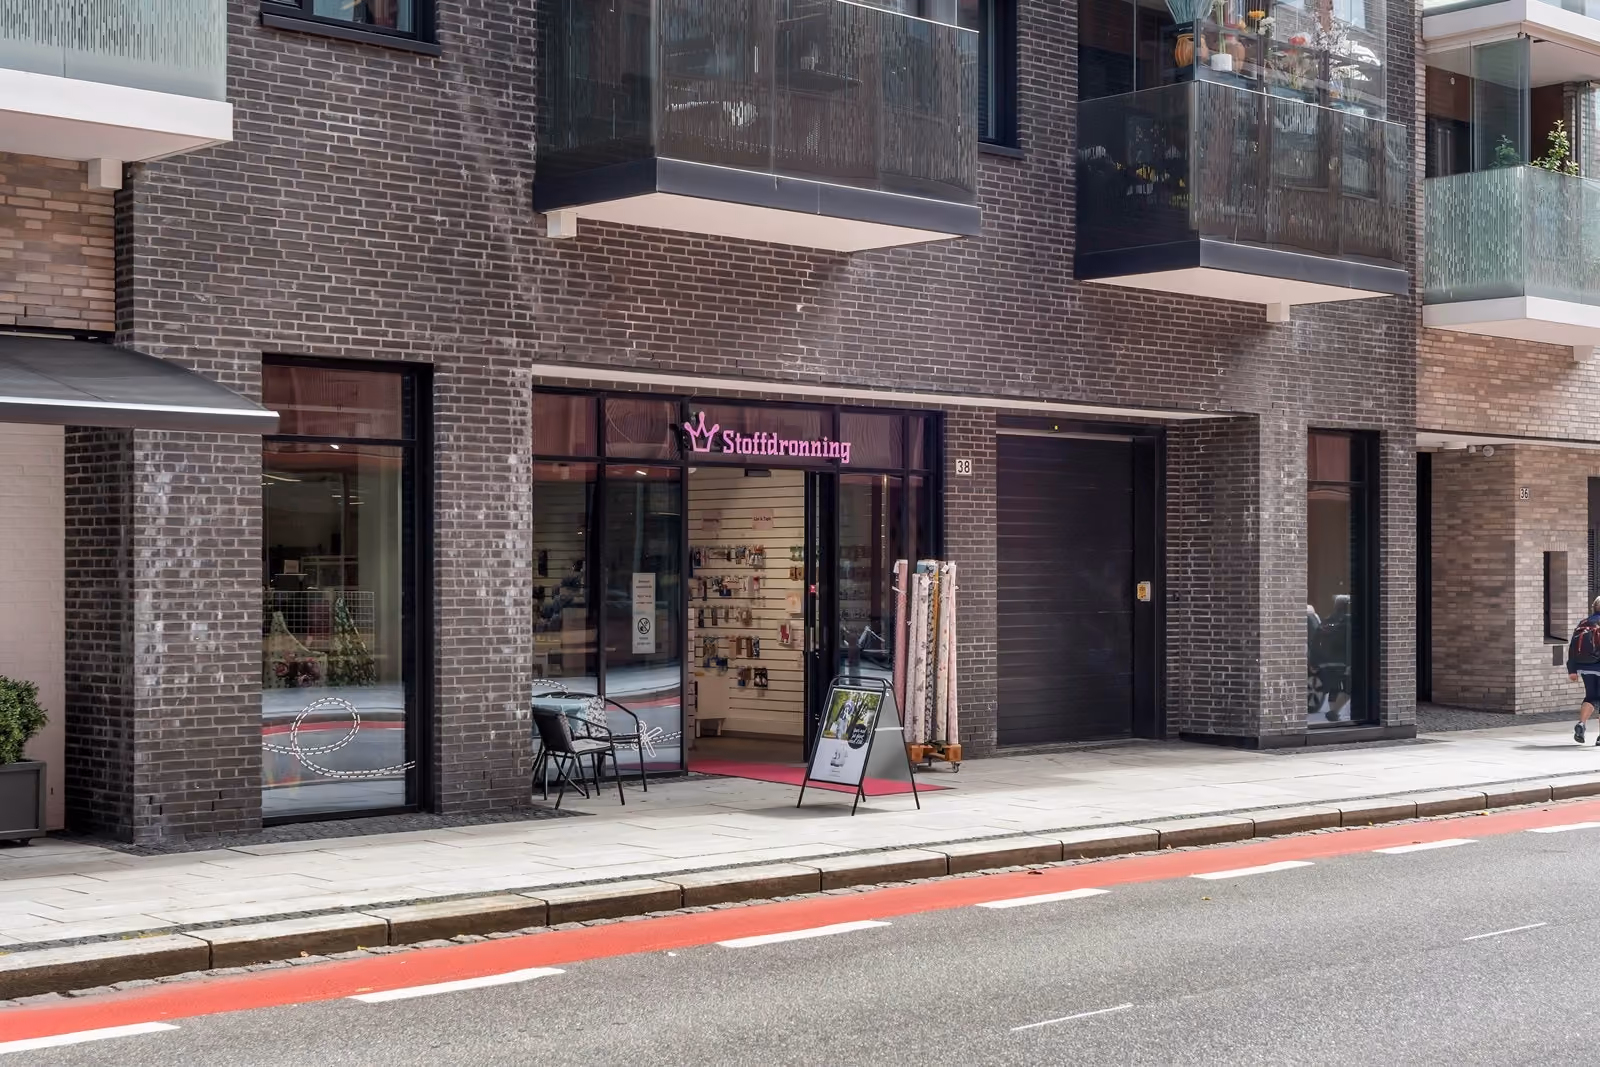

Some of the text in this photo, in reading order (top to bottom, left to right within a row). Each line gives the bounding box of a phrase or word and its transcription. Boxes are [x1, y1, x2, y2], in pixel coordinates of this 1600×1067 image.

[722, 429, 851, 464] Stoffdronning
[957, 460, 970, 473] 38
[1520, 488, 1529, 499] 36
